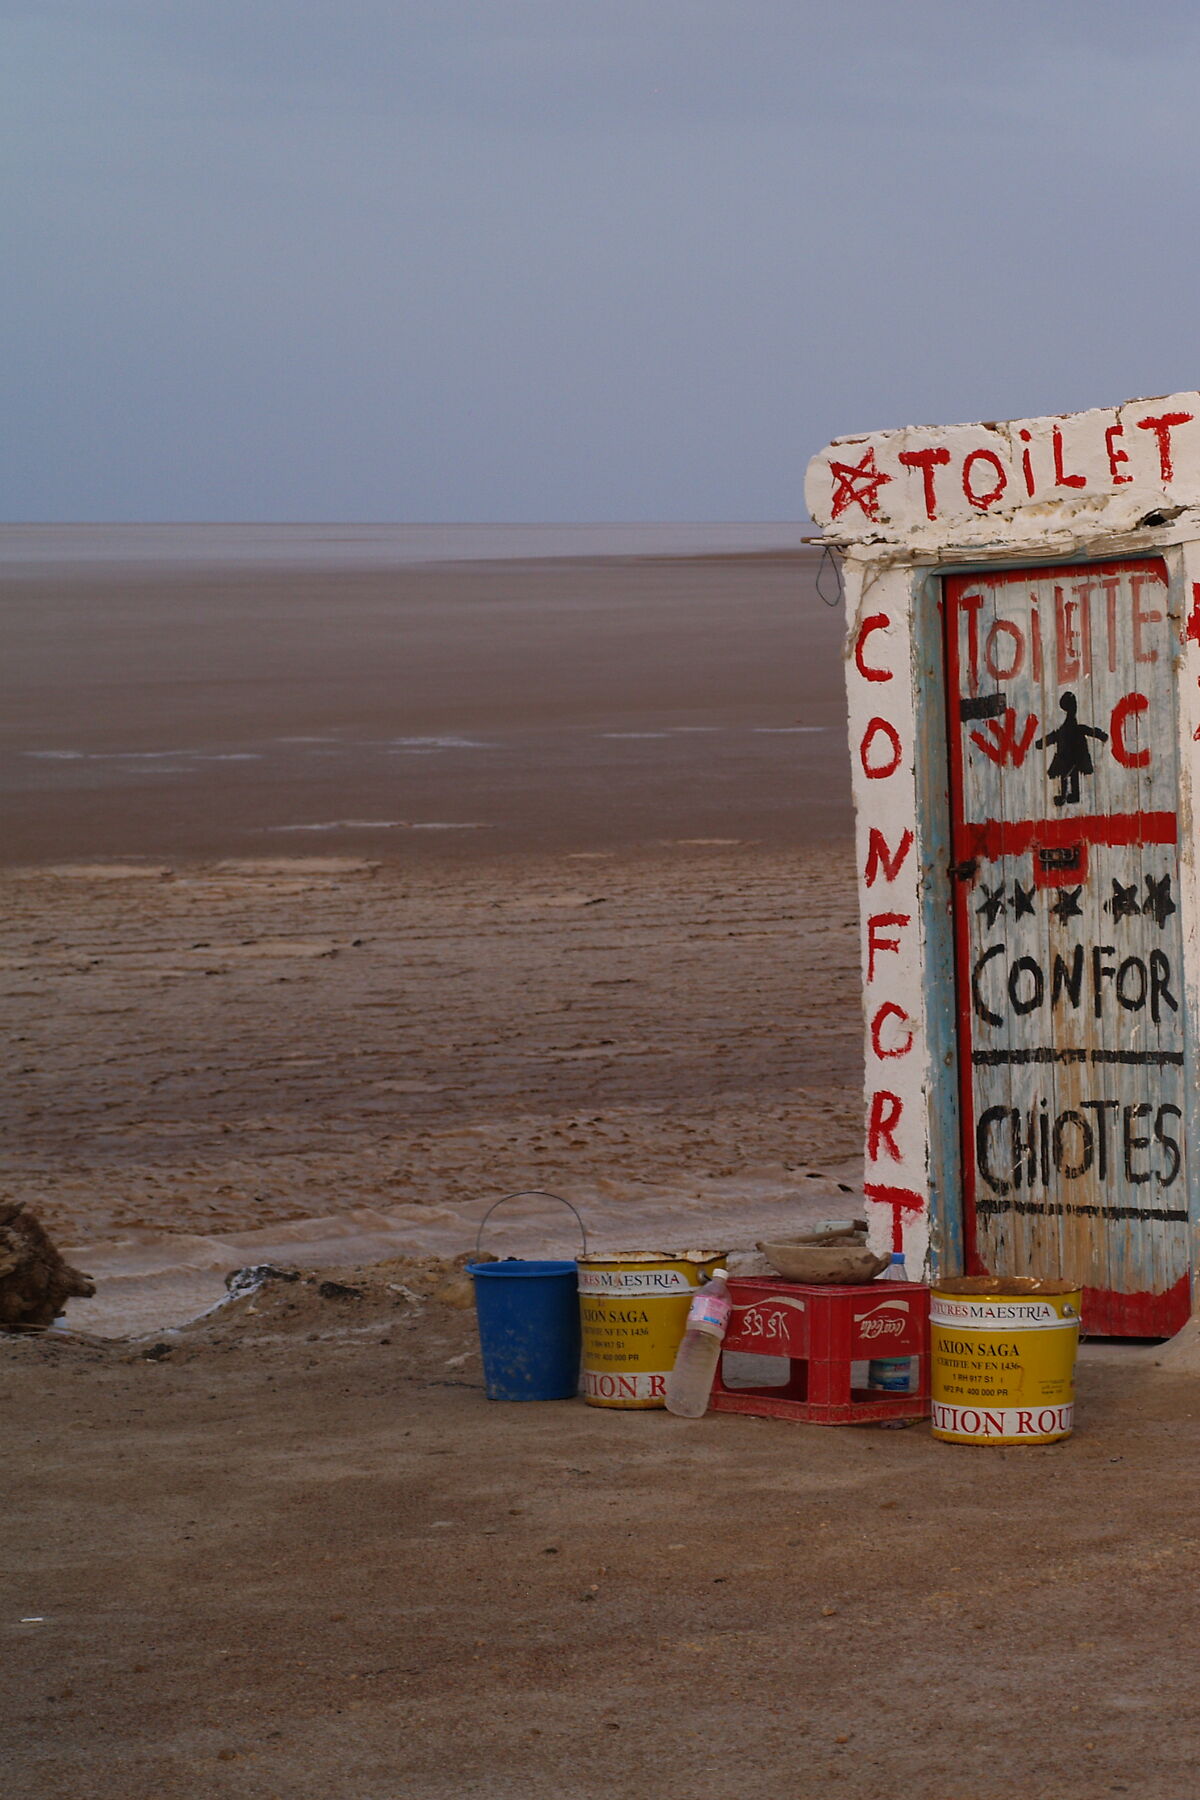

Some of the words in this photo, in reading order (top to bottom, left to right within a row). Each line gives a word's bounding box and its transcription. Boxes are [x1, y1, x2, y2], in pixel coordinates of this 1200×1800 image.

[972, 943, 1179, 1028] CONFOR
[601, 1273, 680, 1289] MAESTRIA
[609, 1310, 648, 1323] SAGA
[970, 1305, 1051, 1321] MAESTRIA
[938, 1337, 975, 1355] AXION
[977, 1343, 1020, 1357] SAGA
